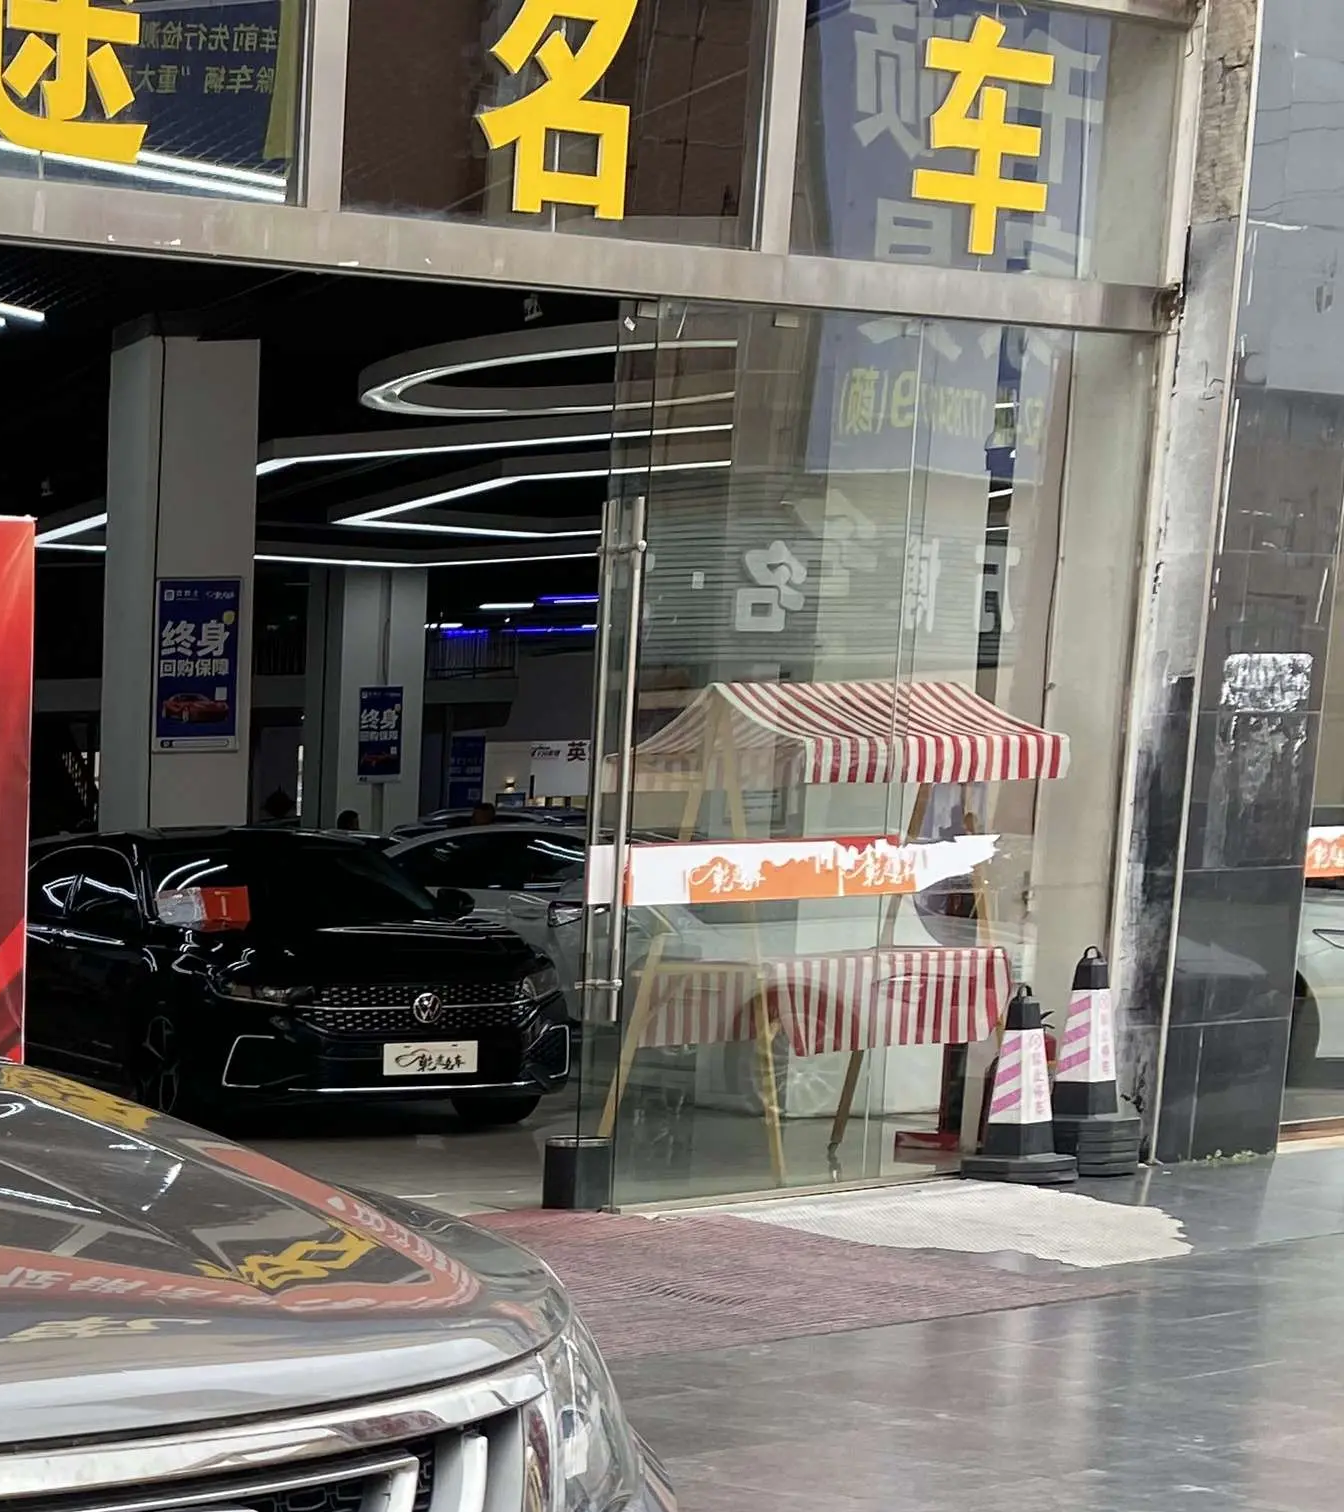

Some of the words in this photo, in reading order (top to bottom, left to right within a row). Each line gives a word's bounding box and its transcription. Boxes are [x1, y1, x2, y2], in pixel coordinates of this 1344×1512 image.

[161, 619, 230, 657] 终身
[159, 658, 230, 678] 回购保障
[567, 741, 591, 762] 英
